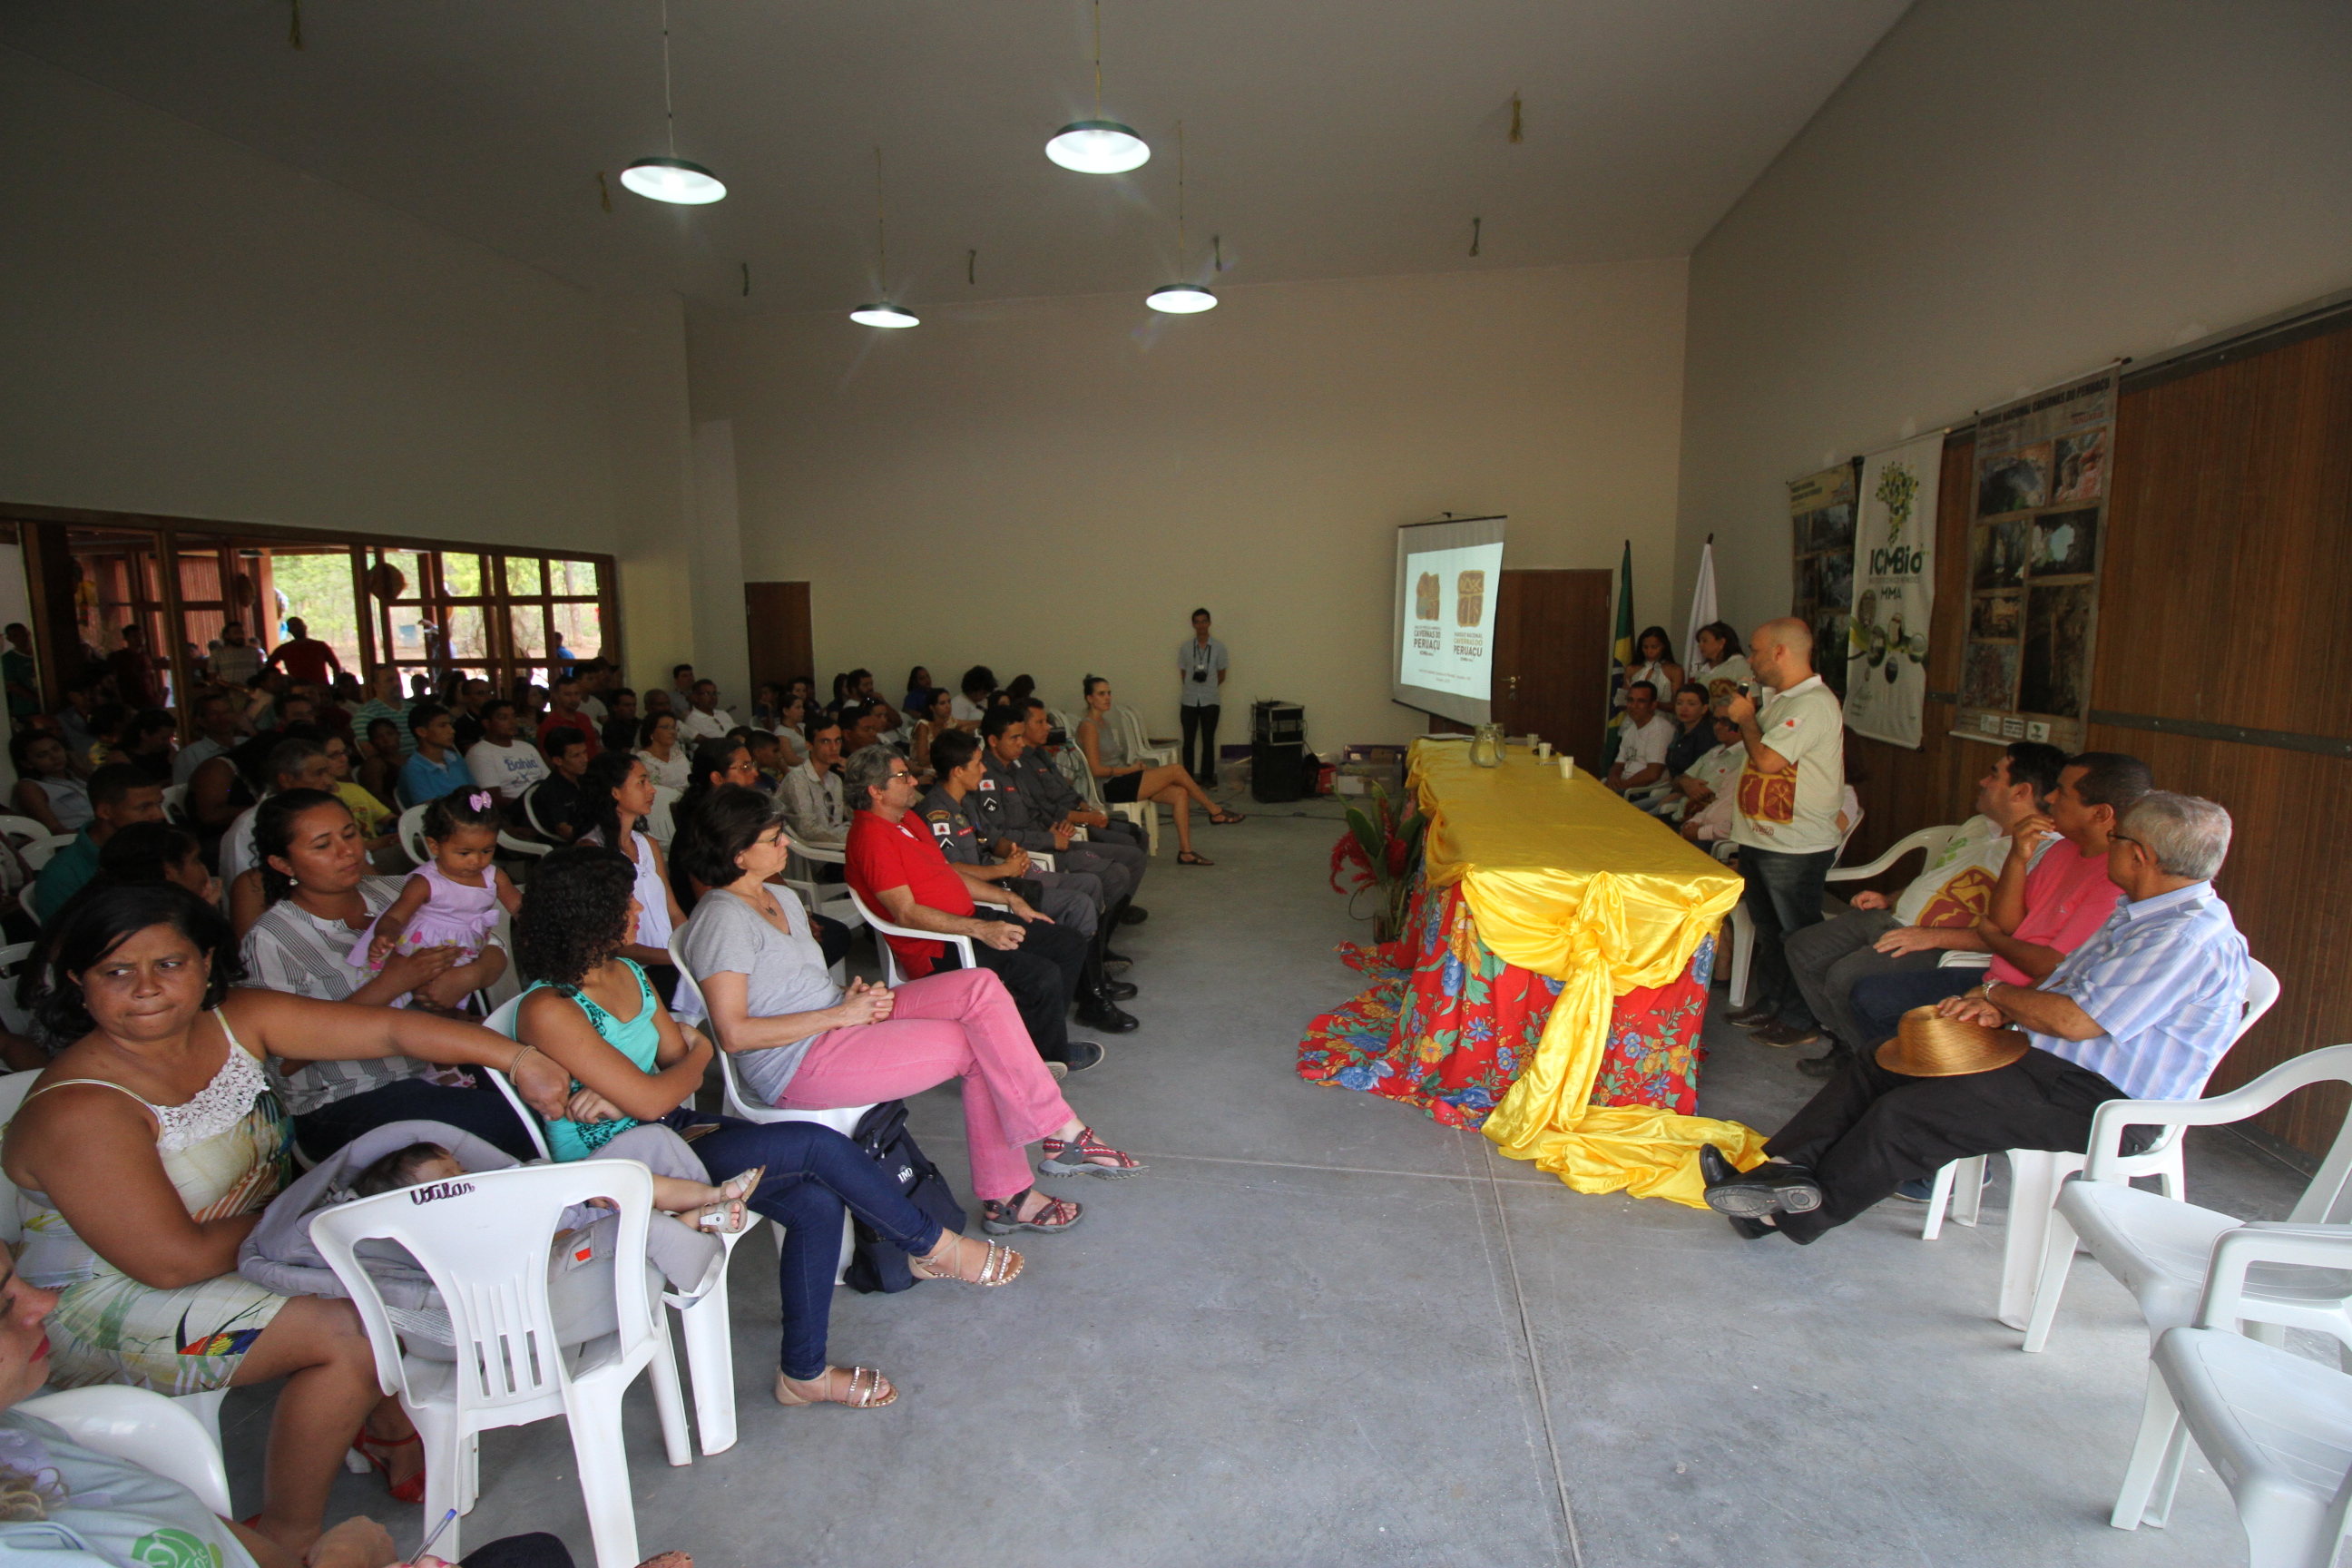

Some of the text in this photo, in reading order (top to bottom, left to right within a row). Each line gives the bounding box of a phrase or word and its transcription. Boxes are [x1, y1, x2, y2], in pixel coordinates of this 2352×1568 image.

[1869, 545, 1923, 575] ICMBio
[1880, 586, 1903, 600] MMA
[1414, 638, 1441, 652] PERUAÇU
[1454, 645, 1484, 659] PERUAÇU
